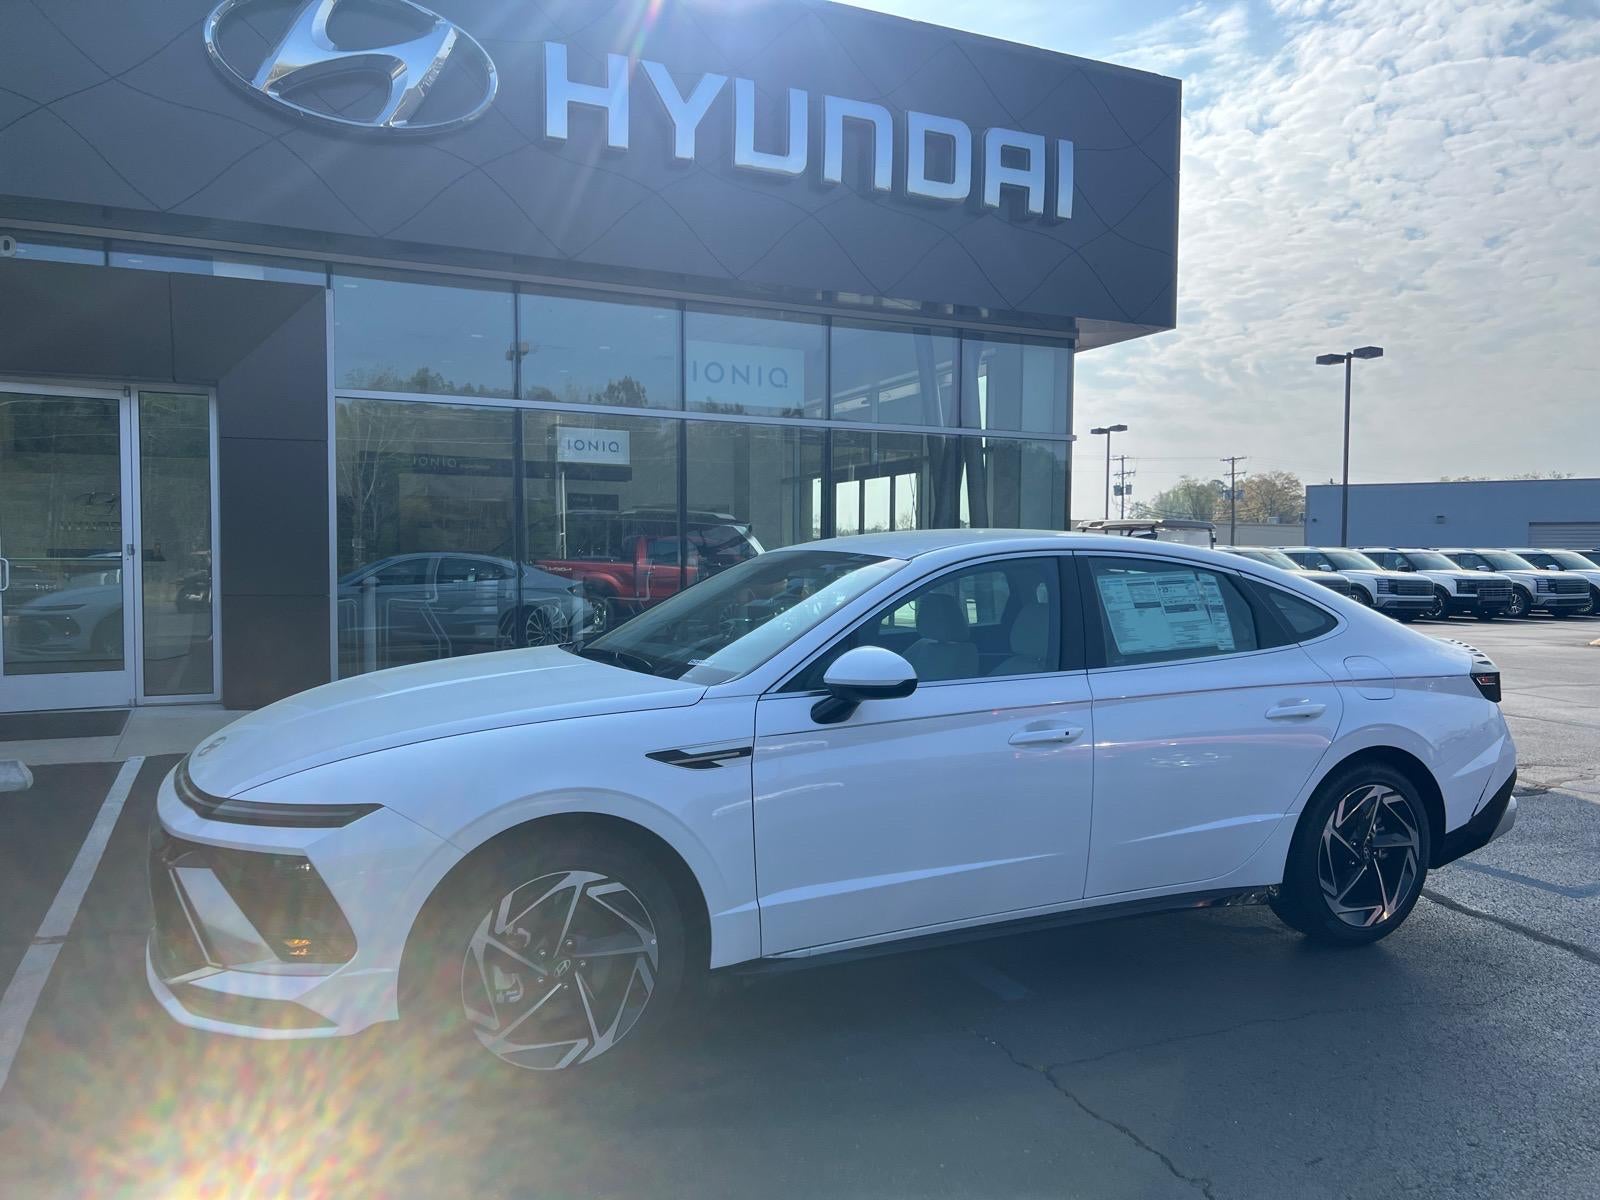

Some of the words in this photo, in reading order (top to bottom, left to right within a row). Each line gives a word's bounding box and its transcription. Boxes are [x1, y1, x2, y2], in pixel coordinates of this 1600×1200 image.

[542, 41, 1074, 221] HYUNDAI
[692, 360, 789, 389] IONIQ
[567, 439, 620, 453] IONIQ
